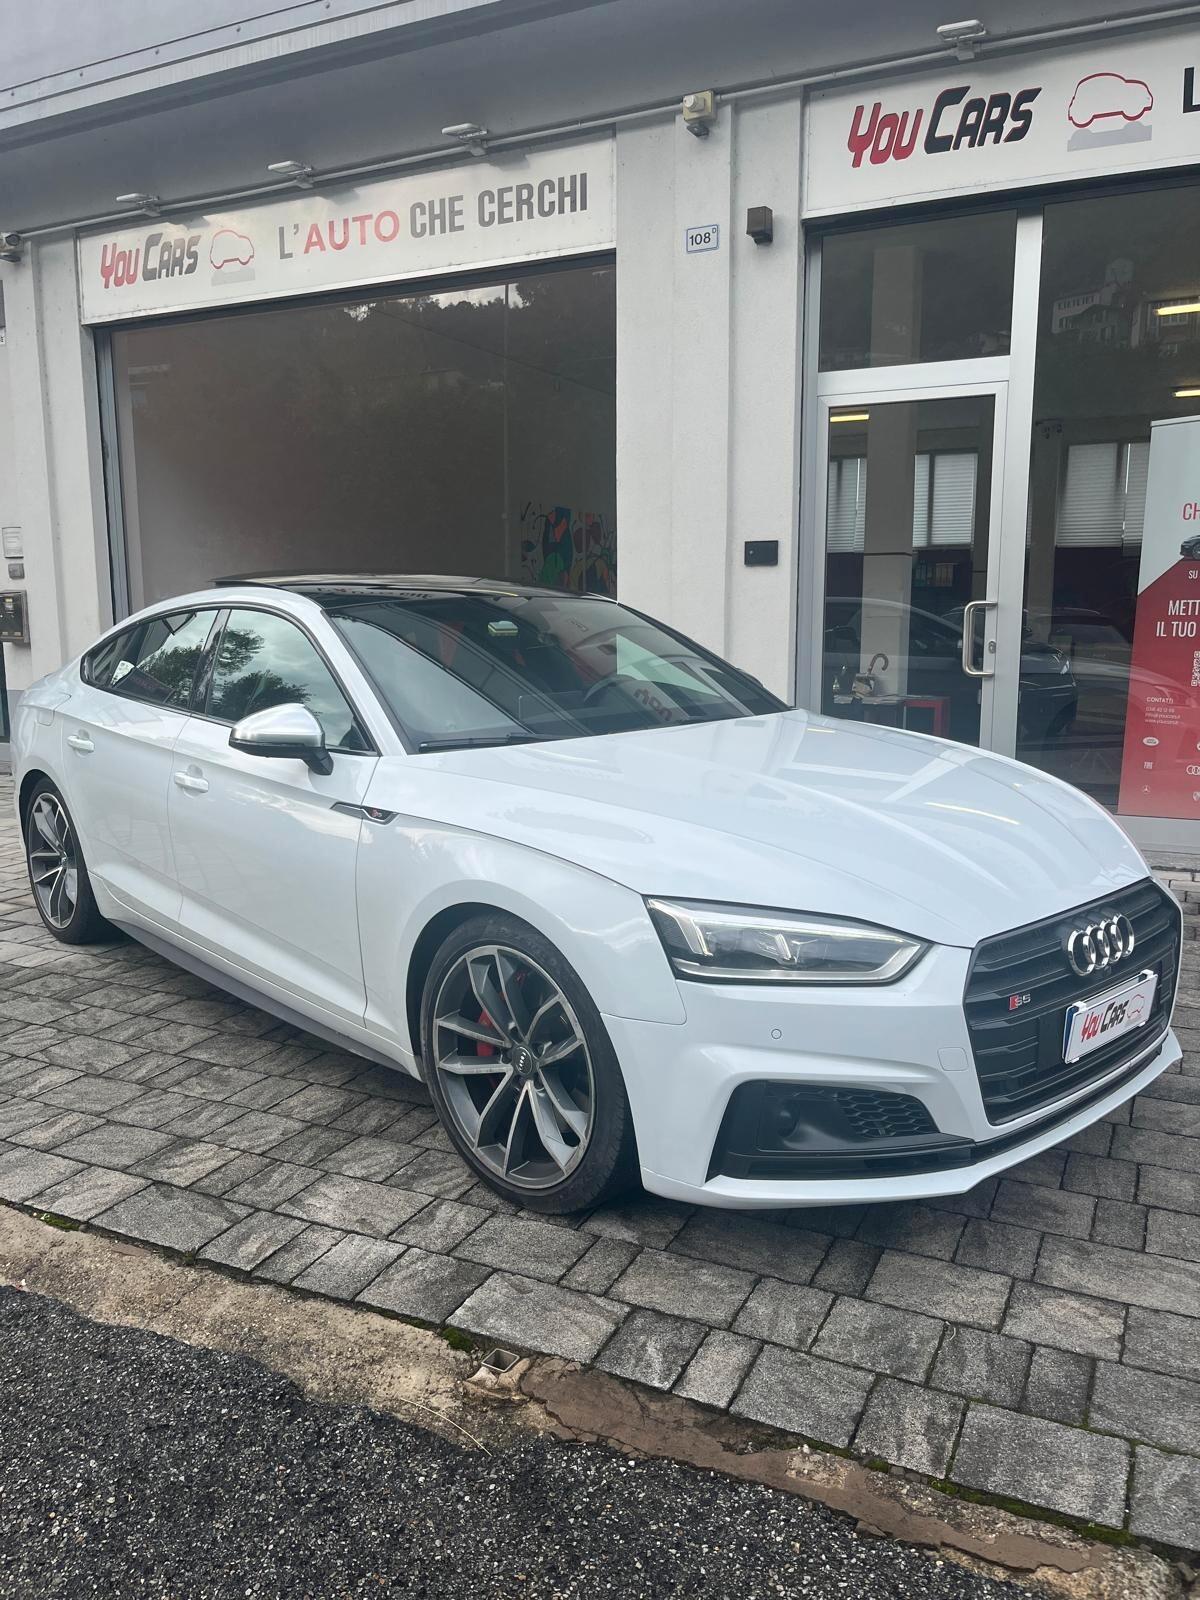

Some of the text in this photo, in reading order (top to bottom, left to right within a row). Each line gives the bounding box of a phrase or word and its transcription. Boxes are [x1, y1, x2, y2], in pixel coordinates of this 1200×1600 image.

[278, 172, 588, 260] L'AUTO CHE CERCHI
[1188, 570, 1199, 579] SU
[1167, 600, 1200, 616] METT
[1156, 621, 1198, 638] IL TUO
